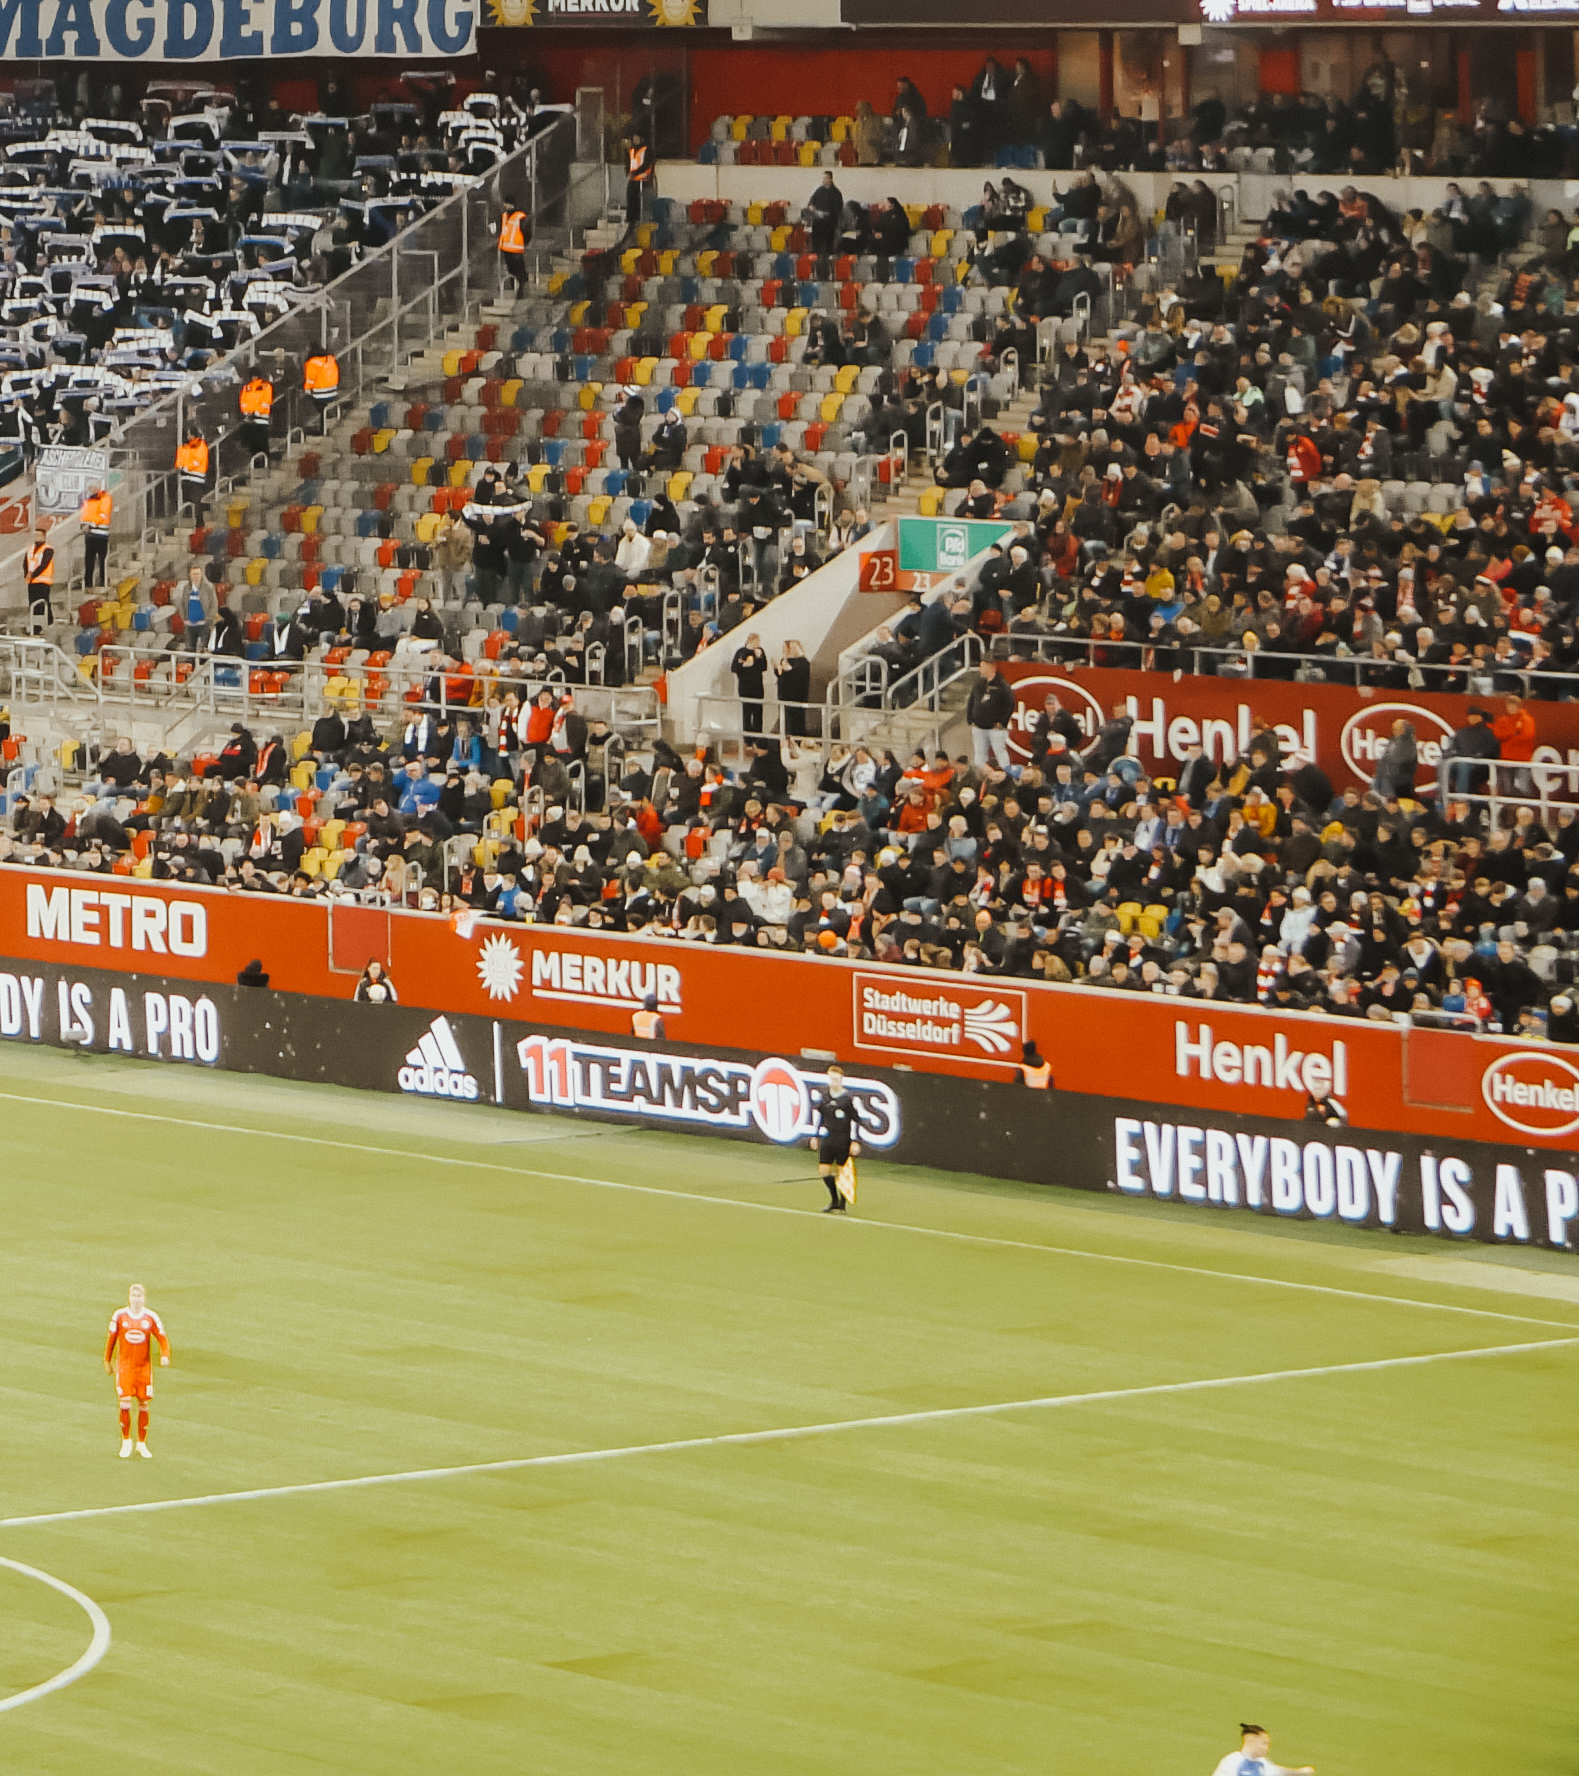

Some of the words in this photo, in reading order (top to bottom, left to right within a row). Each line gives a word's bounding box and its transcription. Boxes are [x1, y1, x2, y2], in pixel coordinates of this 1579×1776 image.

[869, 556, 894, 586] 23
[912, 572, 931, 592] 23
[1126, 695, 1318, 770] Henel
[26, 883, 208, 958] METRO
[531, 950, 681, 1002] MERKUR
[57, 975, 95, 1046] IS
[108, 987, 134, 1052] A
[145, 991, 221, 1064] PRO
[862, 1010, 961, 1044] Düsseldorf
[863, 987, 962, 1020] Stadtwerke
[398, 1064, 478, 1101] adidas
[1175, 1021, 1347, 1096] Henkel
[1492, 1072, 1579, 1113] Henkel
[1115, 1117, 1403, 1224] EVERYBODY
[1420, 1153, 1476, 1236] IS
[1493, 1164, 1530, 1242] A
